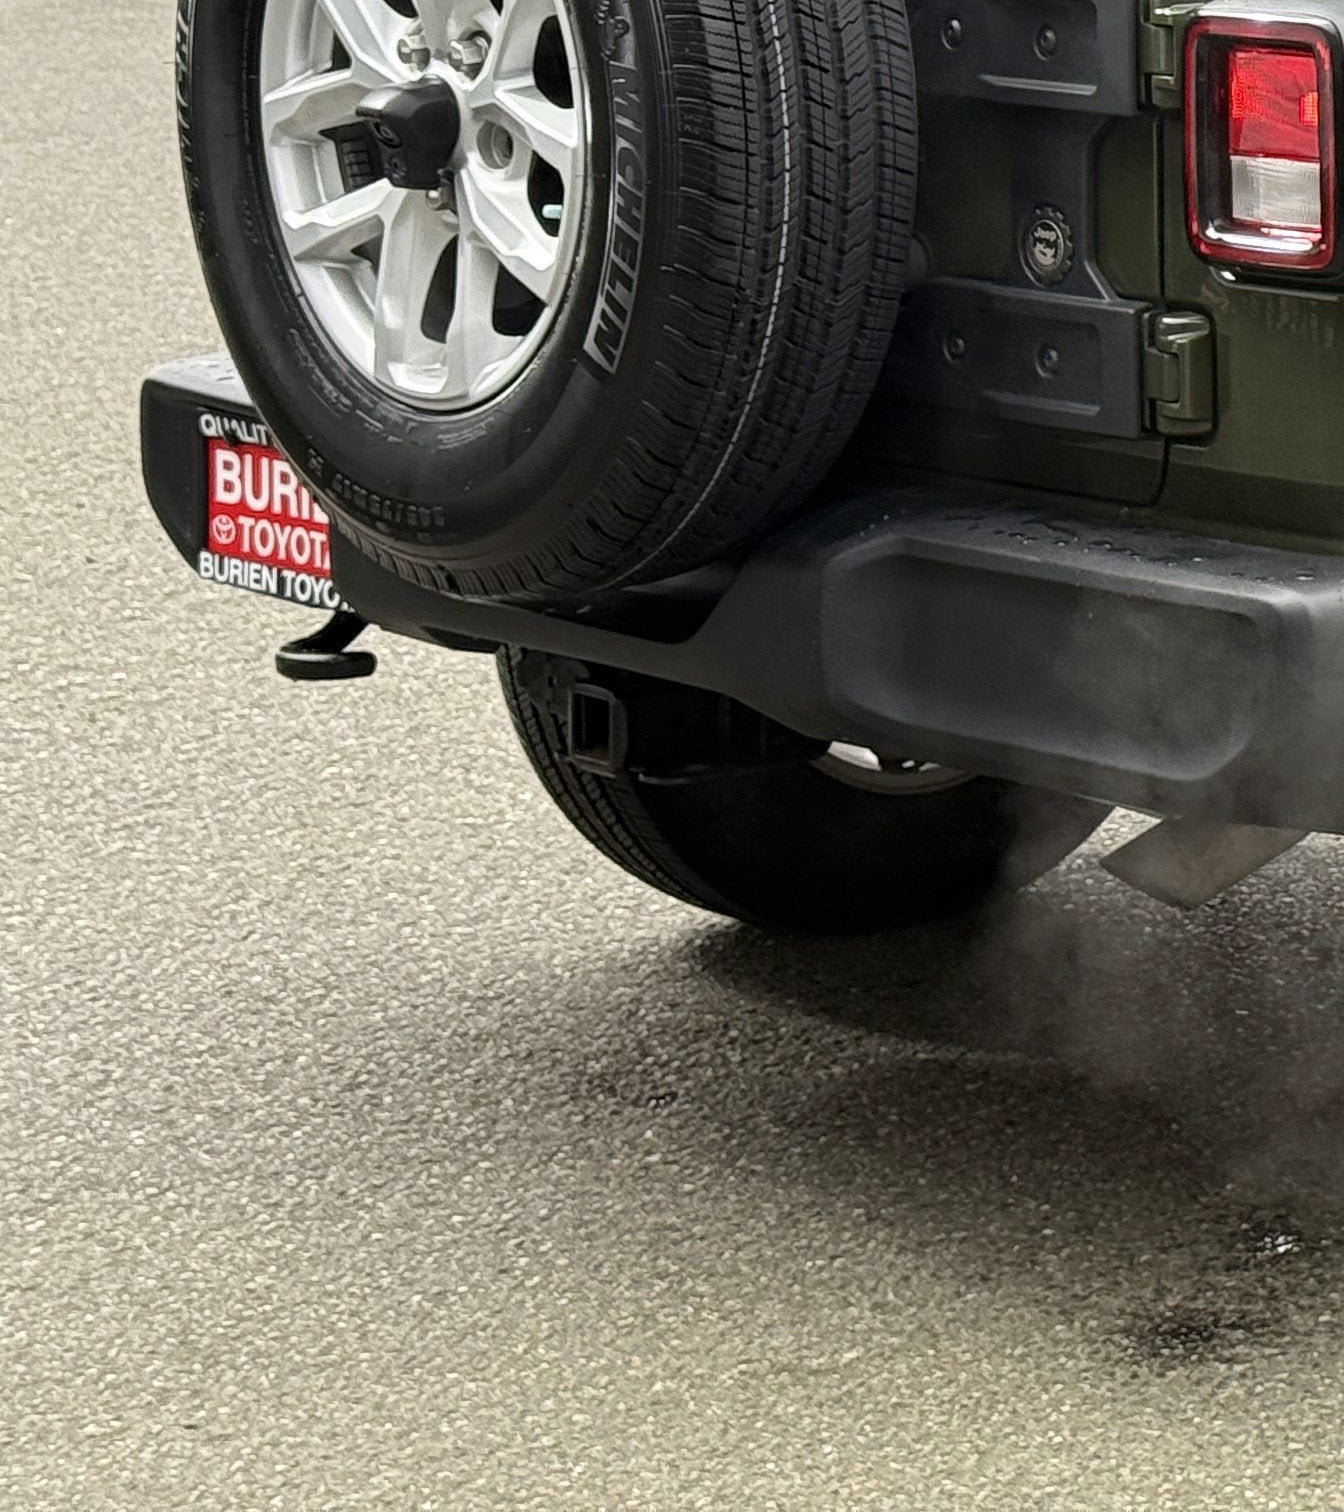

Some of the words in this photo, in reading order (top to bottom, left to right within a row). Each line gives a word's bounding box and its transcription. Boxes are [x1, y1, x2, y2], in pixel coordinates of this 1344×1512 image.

[594, 63, 644, 362] MICHELIN
[200, 413, 274, 447] QUALIT
[200, 551, 279, 595] BURIEN
[280, 570, 356, 614] TOYO
